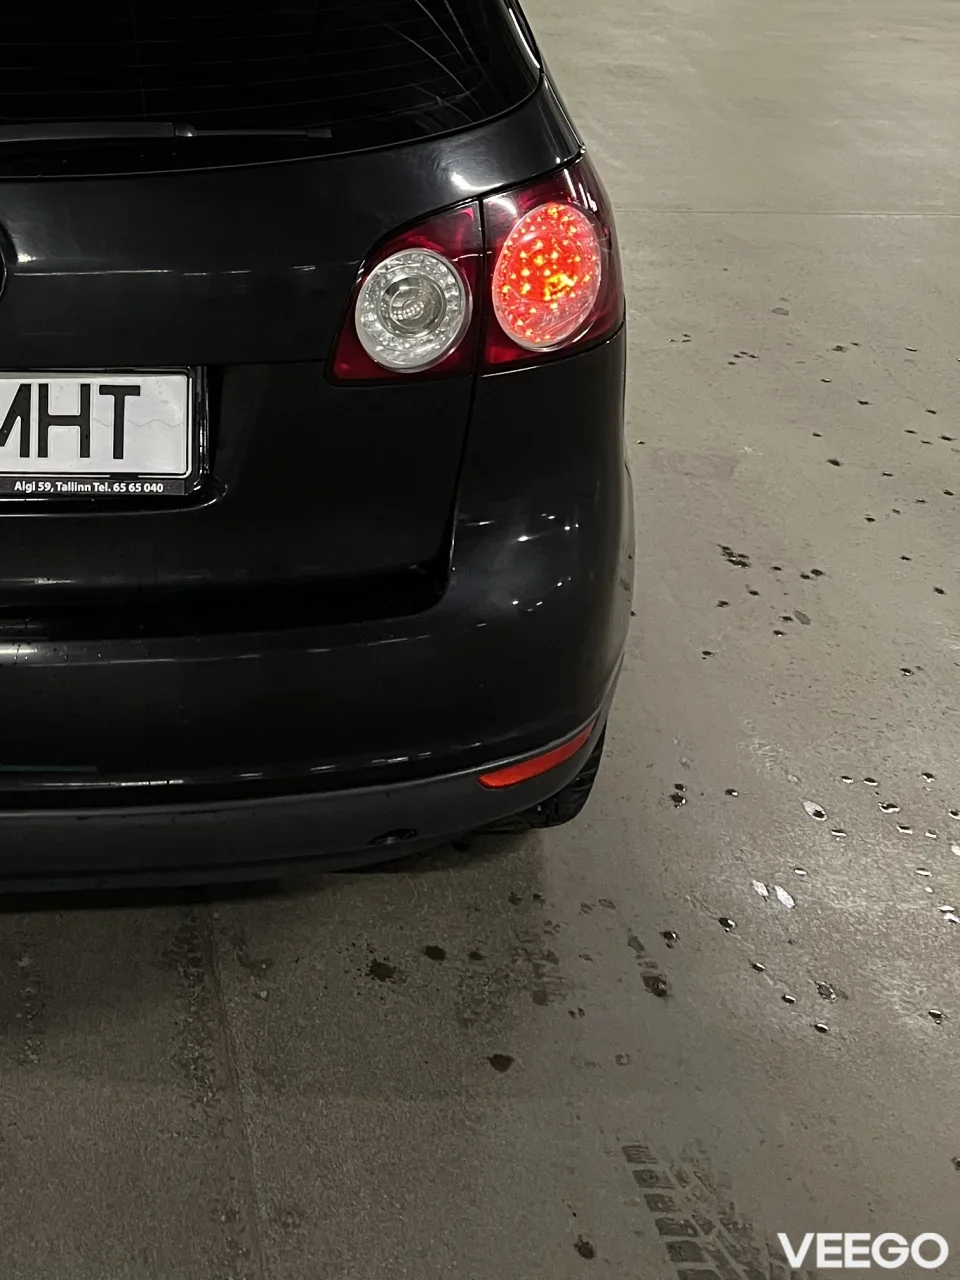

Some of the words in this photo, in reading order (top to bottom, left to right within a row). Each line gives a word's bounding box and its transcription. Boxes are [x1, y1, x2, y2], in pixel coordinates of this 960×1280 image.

[37, 481, 55, 492] 59,
[55, 481, 91, 492] Tallinn
[93, 482, 111, 492] Tel.
[113, 483, 128, 493] 65
[128, 483, 141, 493] 65
[143, 483, 164, 493] 040
